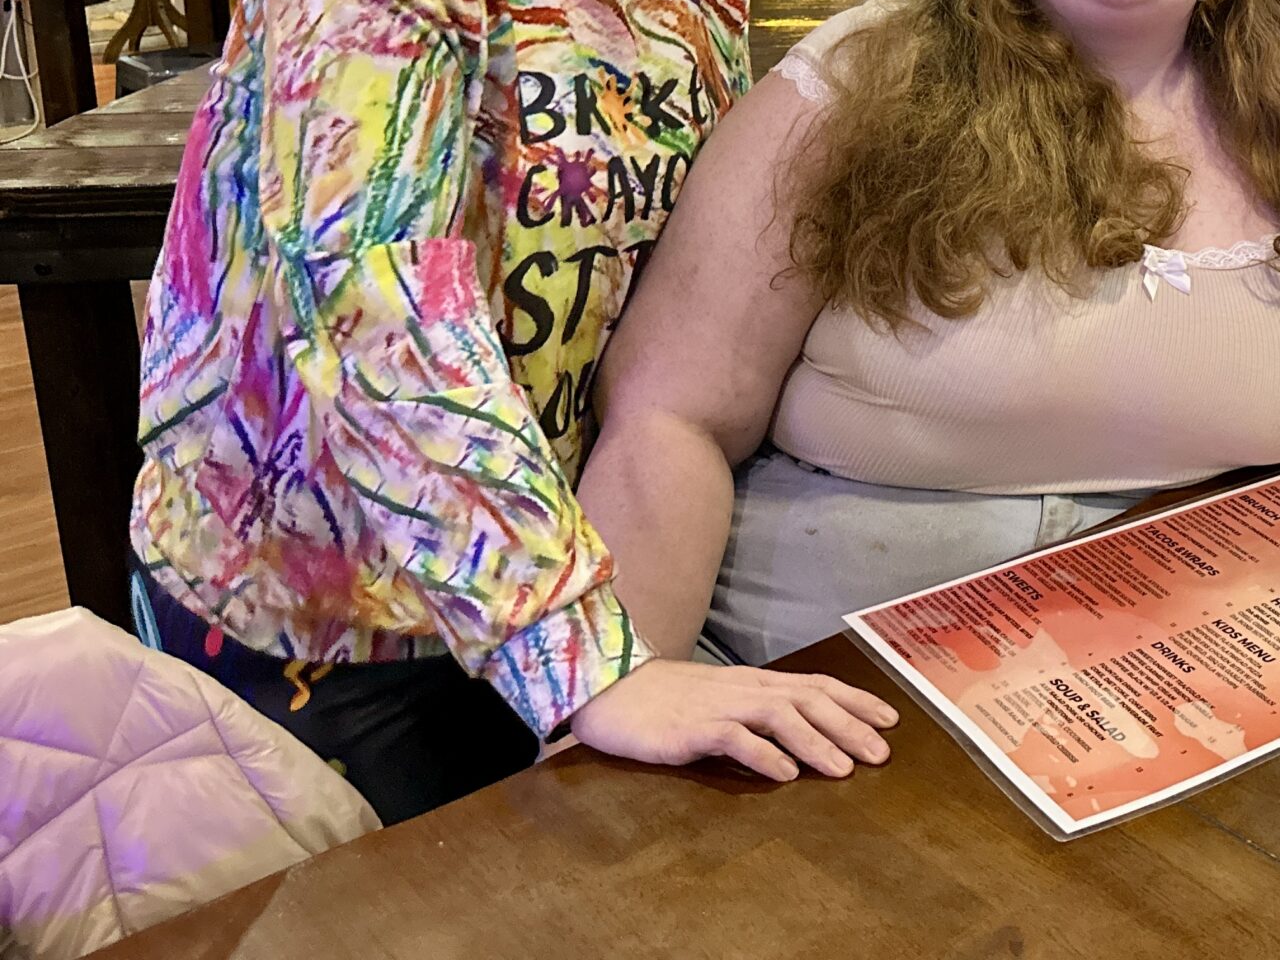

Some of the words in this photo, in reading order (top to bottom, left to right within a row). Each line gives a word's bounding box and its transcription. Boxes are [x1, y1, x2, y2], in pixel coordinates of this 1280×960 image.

[1142, 525, 1180, 547] TACOS
[1000, 570, 1045, 600] SWEETS
[1149, 641, 1197, 673] DRINKS
[1210, 619, 1243, 639] KIDS
[1236, 638, 1276, 663] MENU
[1047, 677, 1084, 703] SOUP
[1076, 702, 1092, 711] &
[1084, 709, 1128, 742] SALAD
